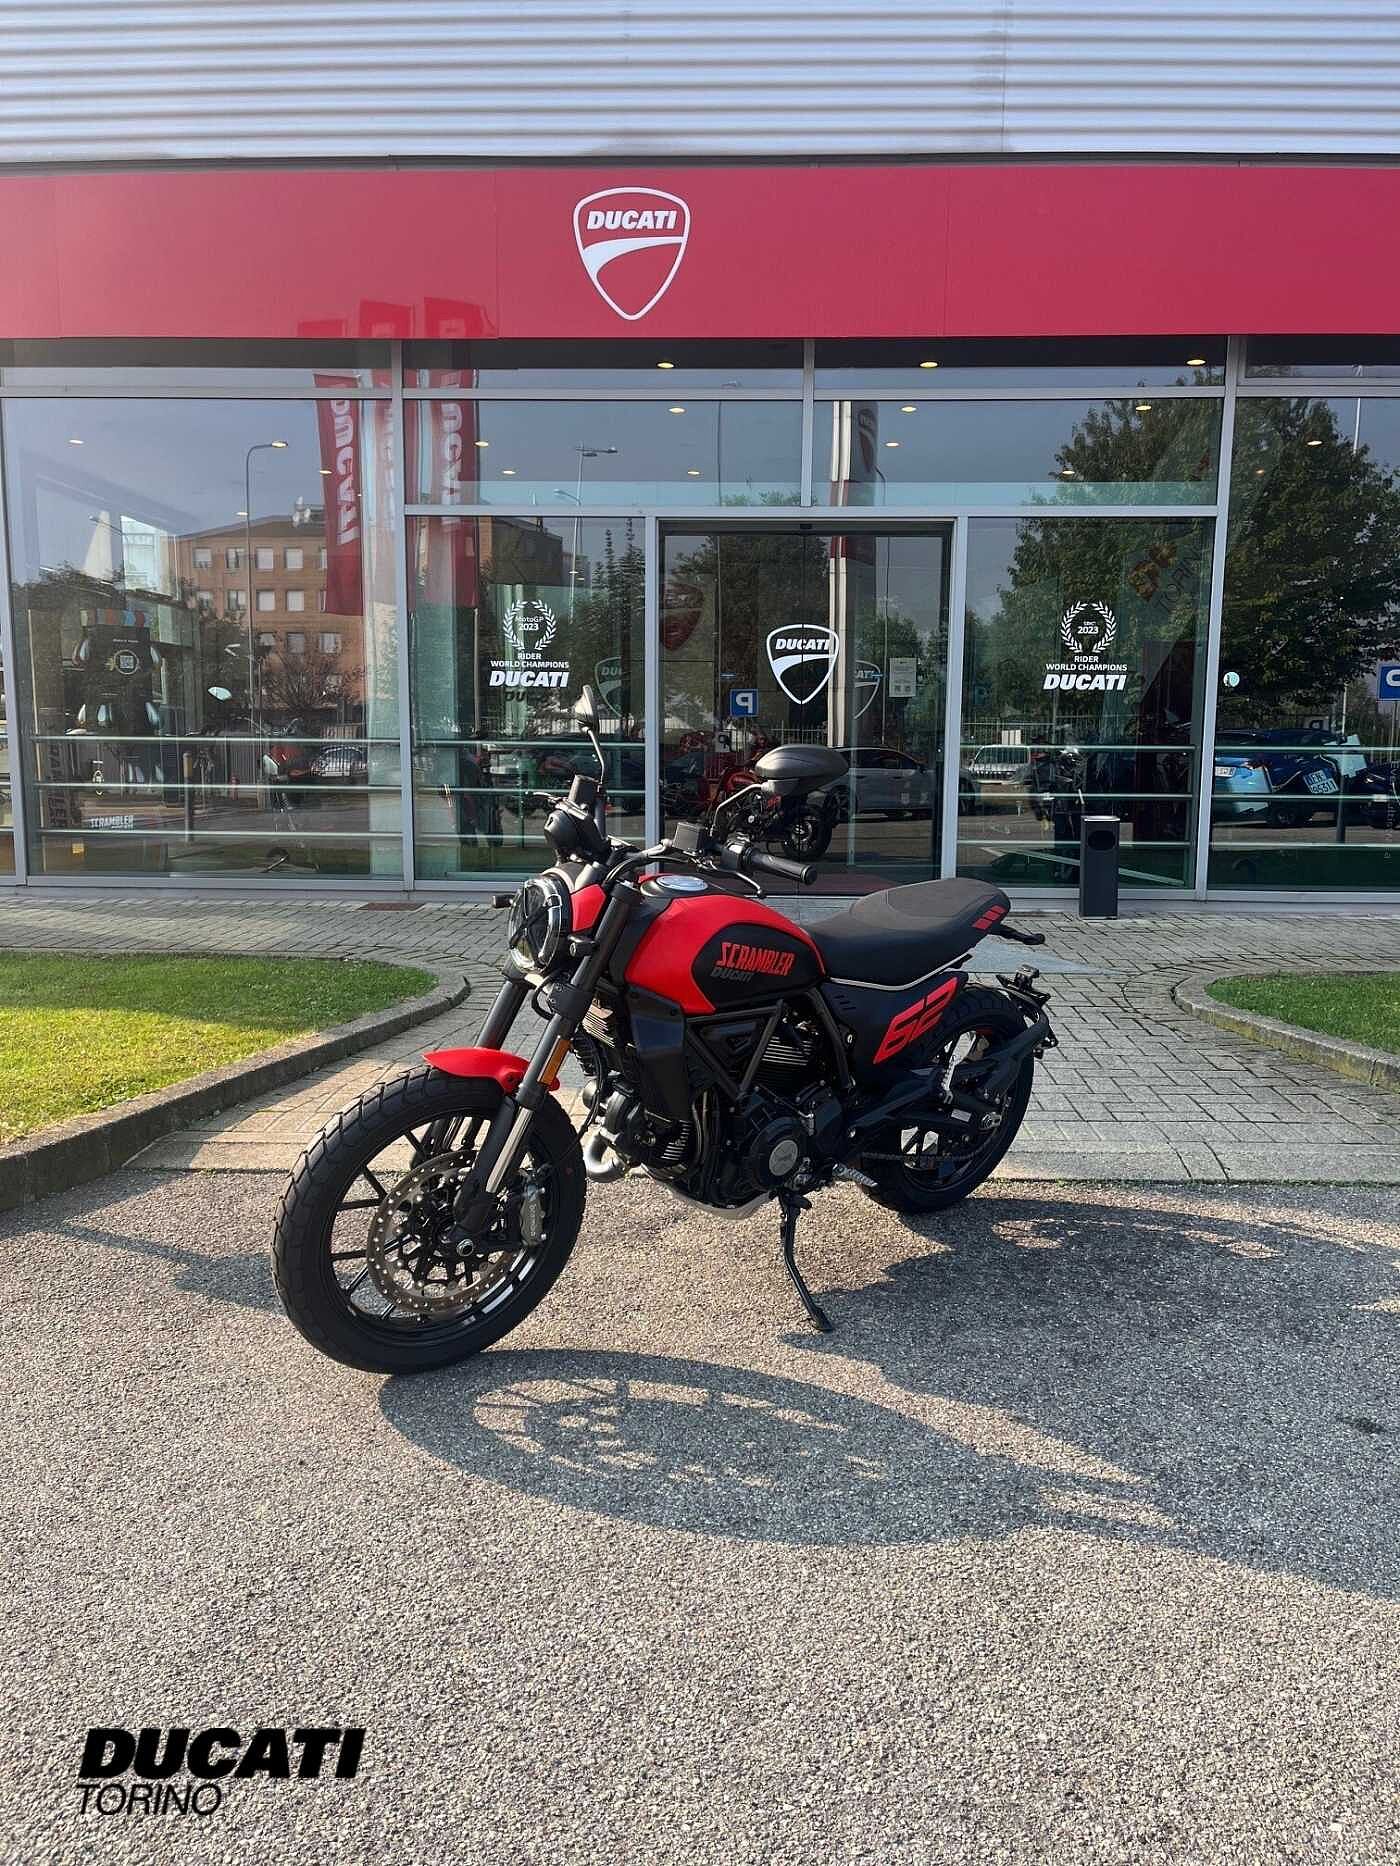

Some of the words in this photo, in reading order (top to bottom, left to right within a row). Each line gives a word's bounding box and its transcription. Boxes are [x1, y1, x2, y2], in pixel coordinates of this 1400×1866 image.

[586, 210, 678, 230] DUCATI
[518, 623, 540, 631] 2023
[1077, 626, 1099, 634] 2023
[775, 638, 832, 651] DUCATI
[517, 652, 542, 660] RIDER
[1074, 655, 1099, 663] RIDER
[490, 660, 520, 668] WORLD
[521, 661, 570, 669] CHAMPIONS
[1046, 663, 1077, 671] WORLD
[1077, 664, 1128, 672] CHAMPIONS
[489, 670, 570, 688] DUCATI
[1043, 673, 1127, 691] DUCATI
[715, 941, 796, 977] SCRAMBLER
[710, 966, 754, 983] DUCATI
[872, 976, 958, 1065] 62
